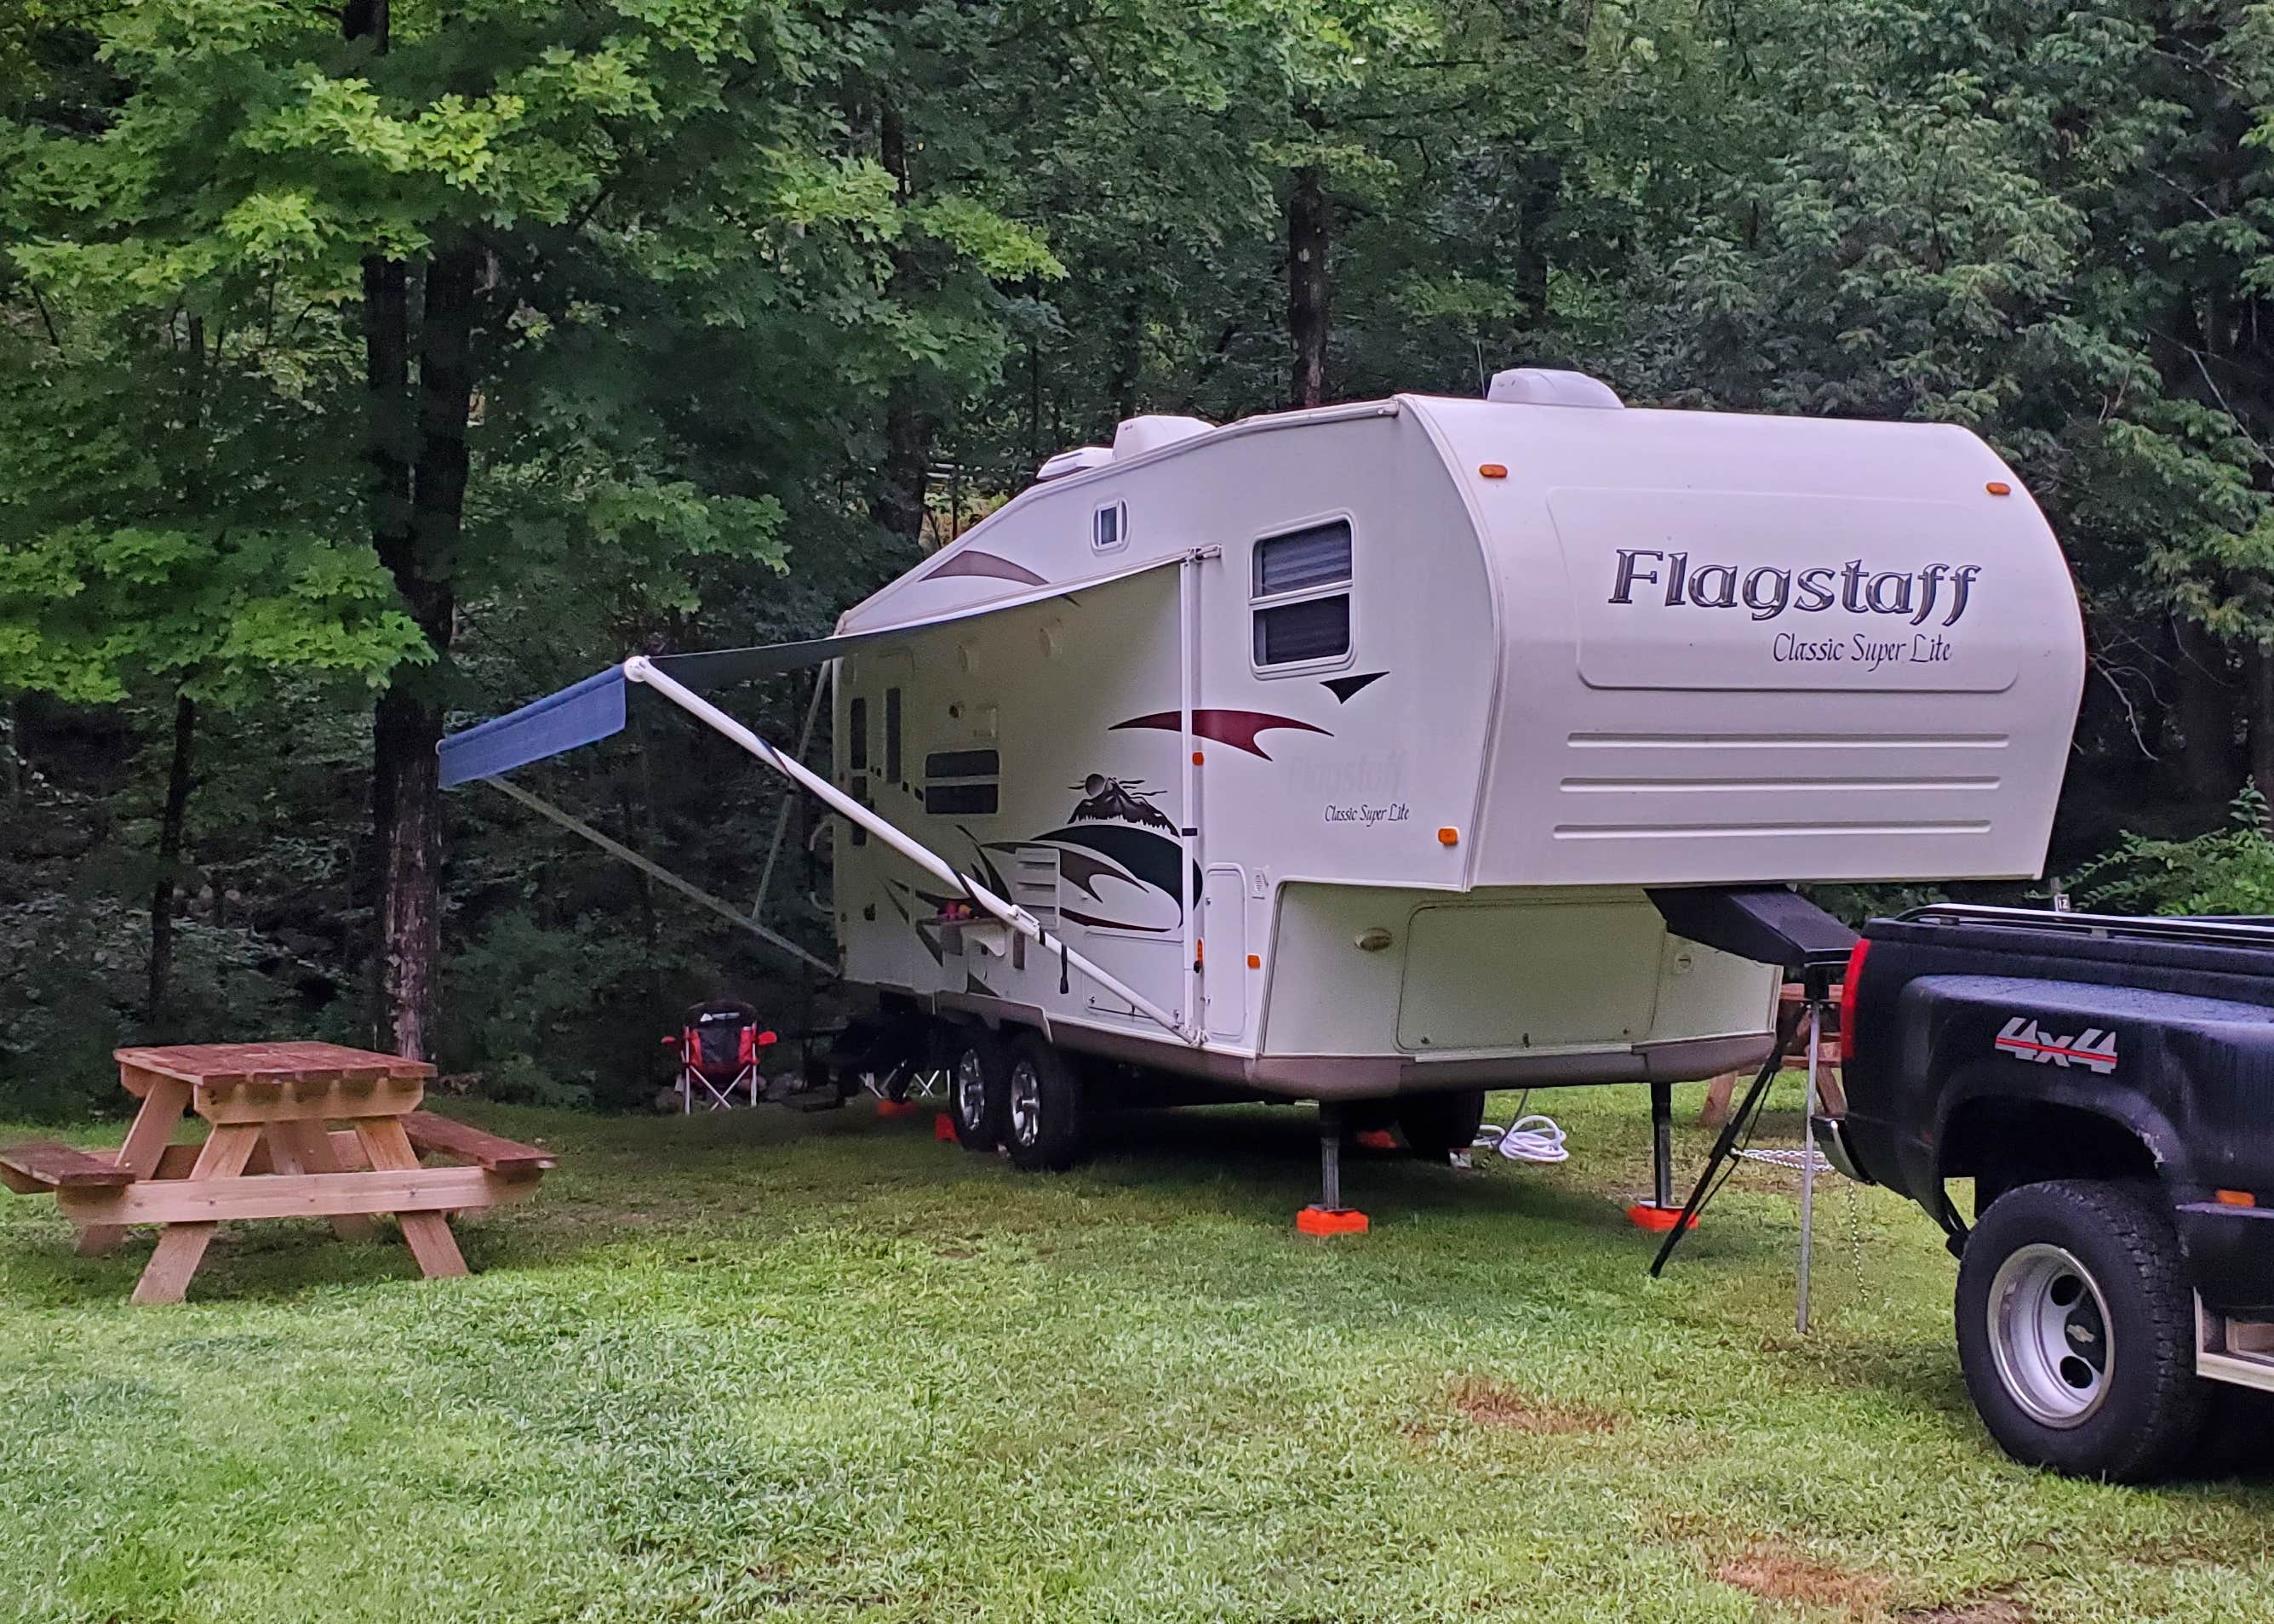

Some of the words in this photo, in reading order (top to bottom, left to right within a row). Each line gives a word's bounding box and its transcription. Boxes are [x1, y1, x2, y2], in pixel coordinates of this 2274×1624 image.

[1607, 549, 1983, 626] Flagstaff
[1773, 633, 1845, 662] Classic
[1850, 633, 1906, 672] Super
[1910, 633, 1952, 663] Lite
[1325, 804, 1359, 822] Classic
[1360, 804, 1387, 828] Super
[1388, 803, 1410, 822] Lite
[1996, 1017, 2118, 1074] 4x4
